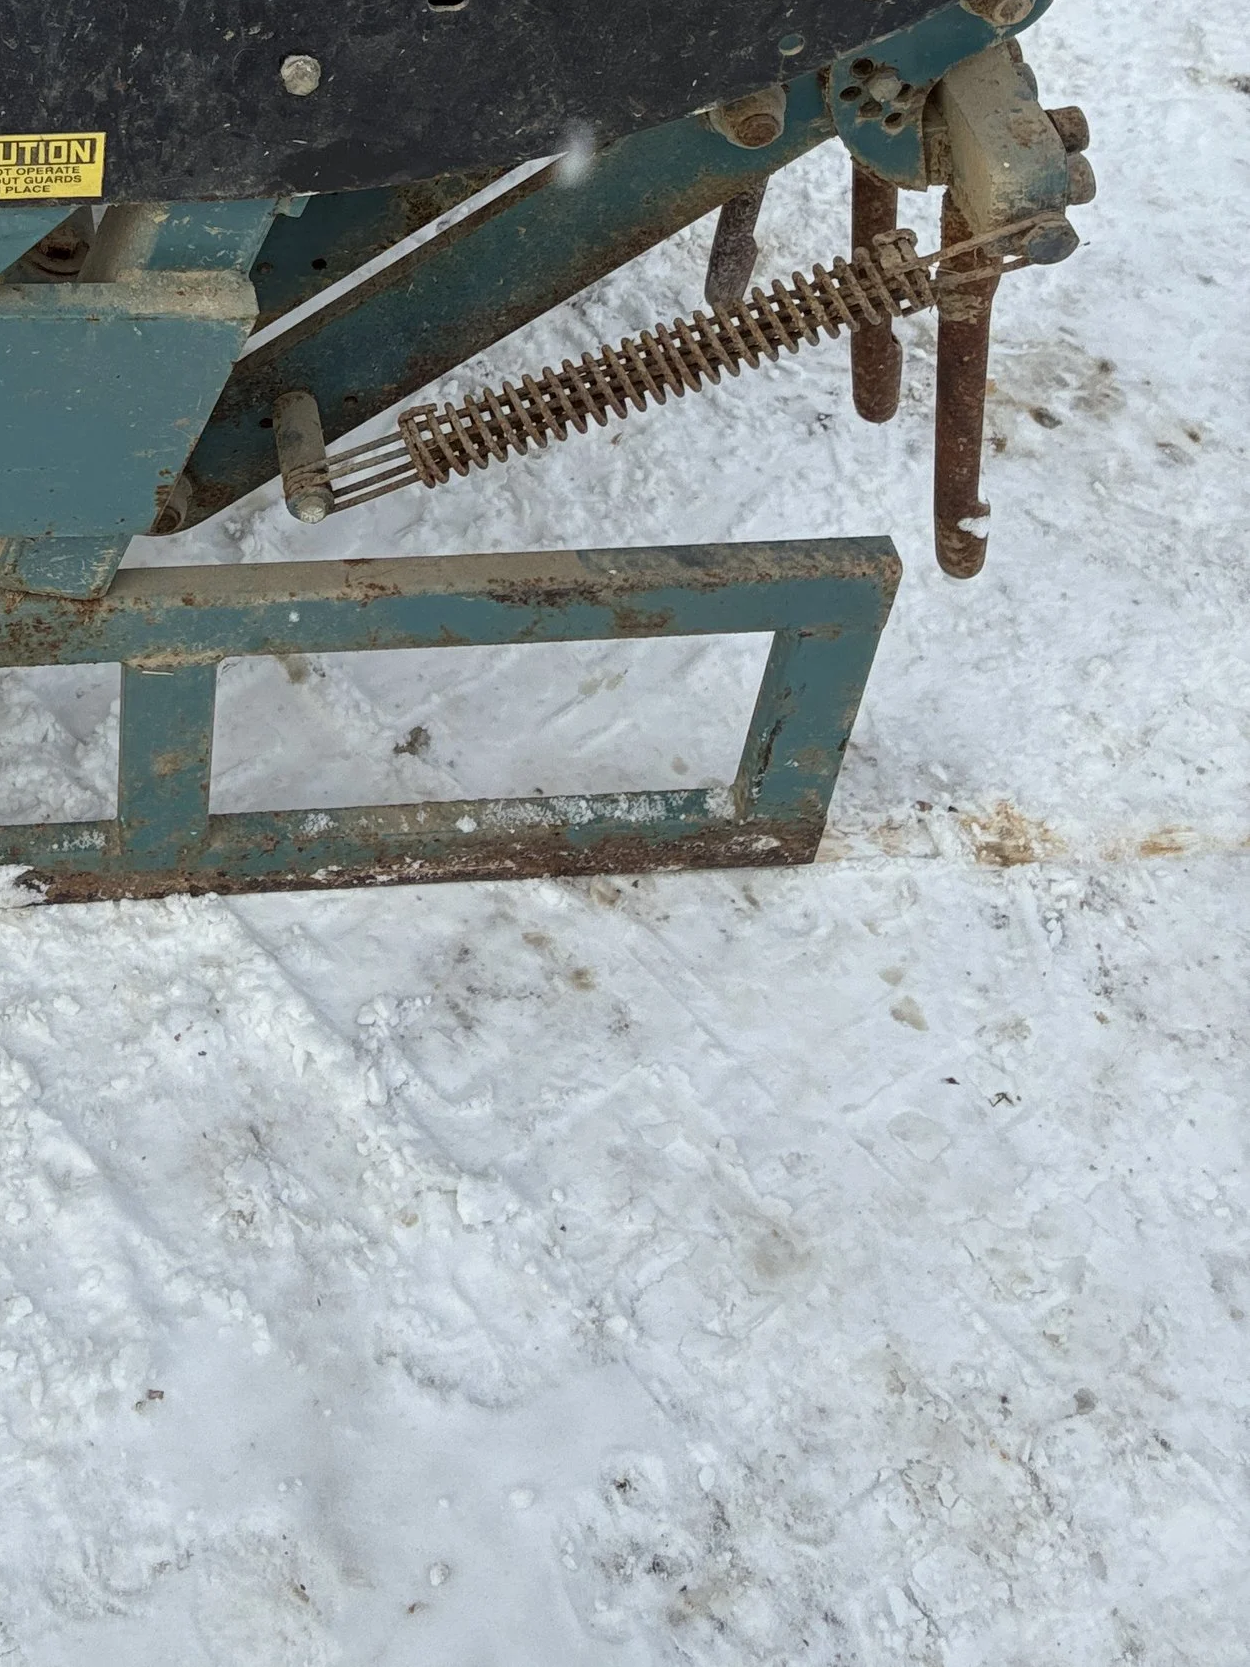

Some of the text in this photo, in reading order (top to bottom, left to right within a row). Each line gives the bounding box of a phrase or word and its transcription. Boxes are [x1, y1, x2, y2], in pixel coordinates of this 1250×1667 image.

[16, 166, 80, 176] OPERATE
[24, 175, 82, 185] GUARDS
[5, 185, 51, 194] PLACE
